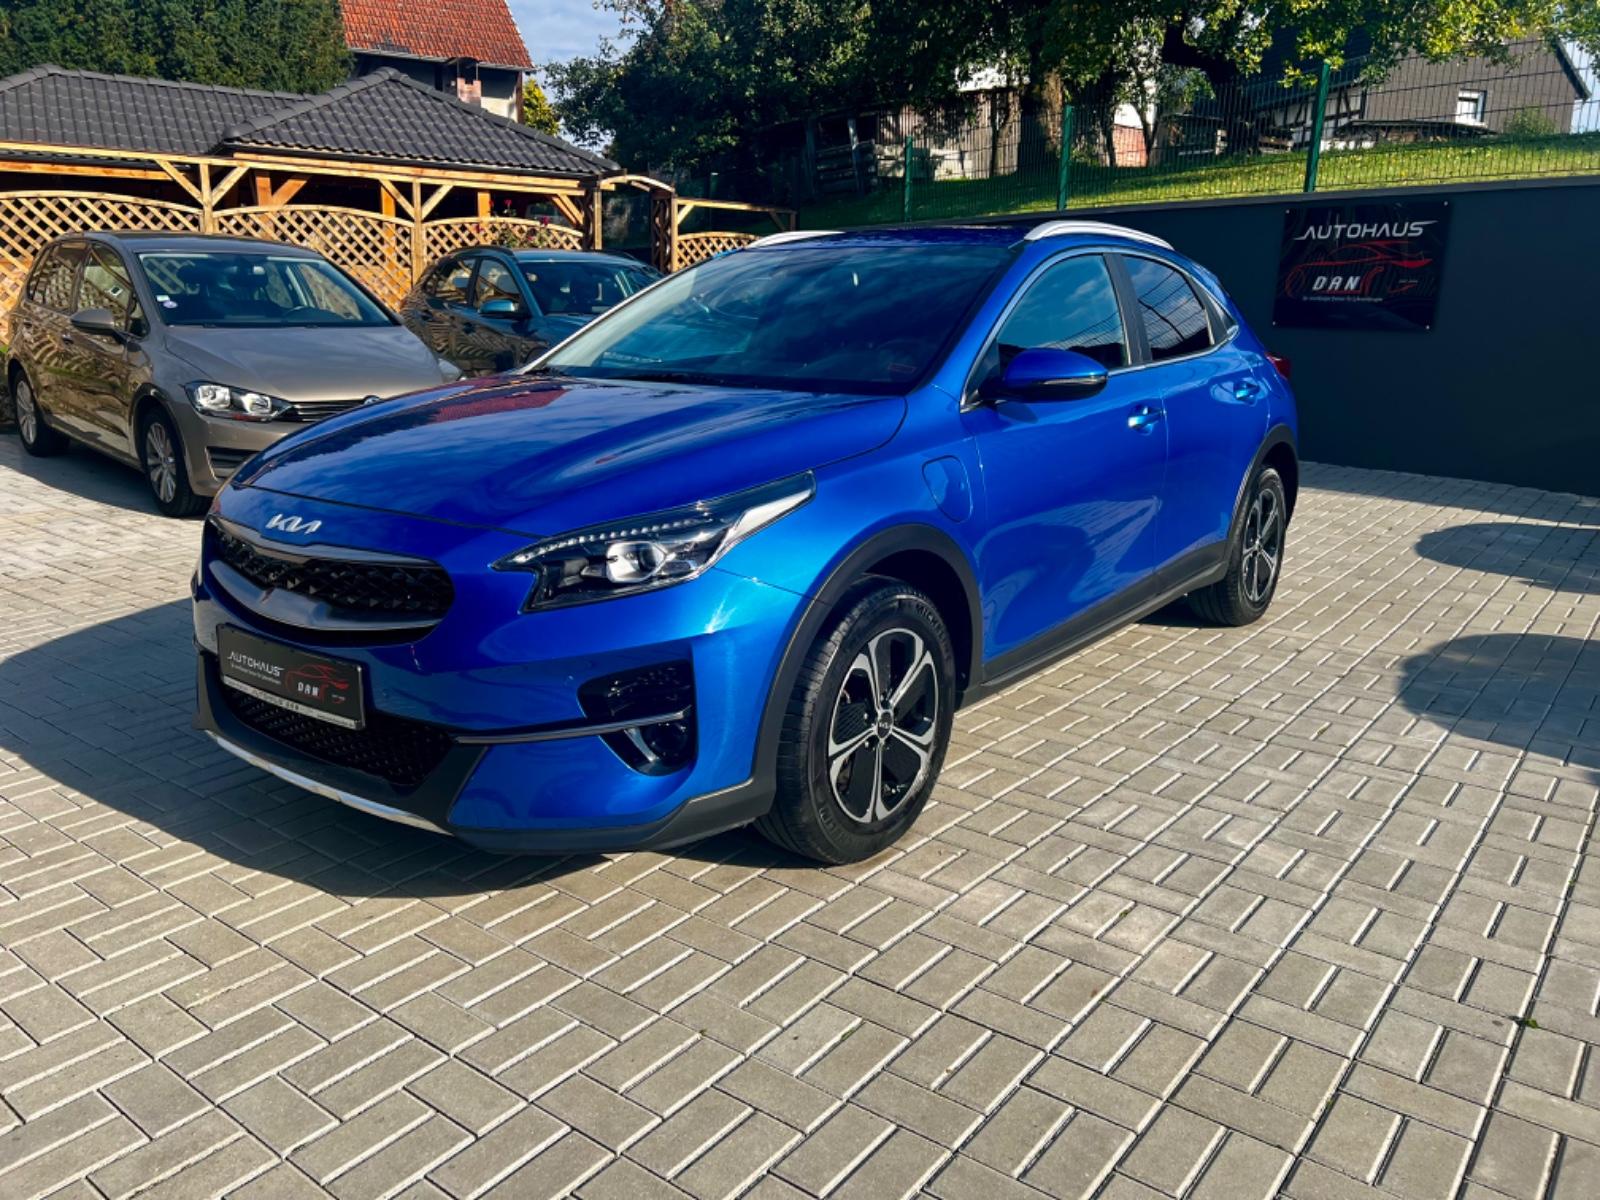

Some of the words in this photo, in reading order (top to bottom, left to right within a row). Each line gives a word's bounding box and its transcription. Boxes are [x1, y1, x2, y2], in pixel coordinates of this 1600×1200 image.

[1294, 220, 1439, 241] AUTOHAUS
[1312, 275, 1361, 291] DAN
[227, 651, 284, 676] AUTOHAUS
[297, 681, 320, 697] DAN
